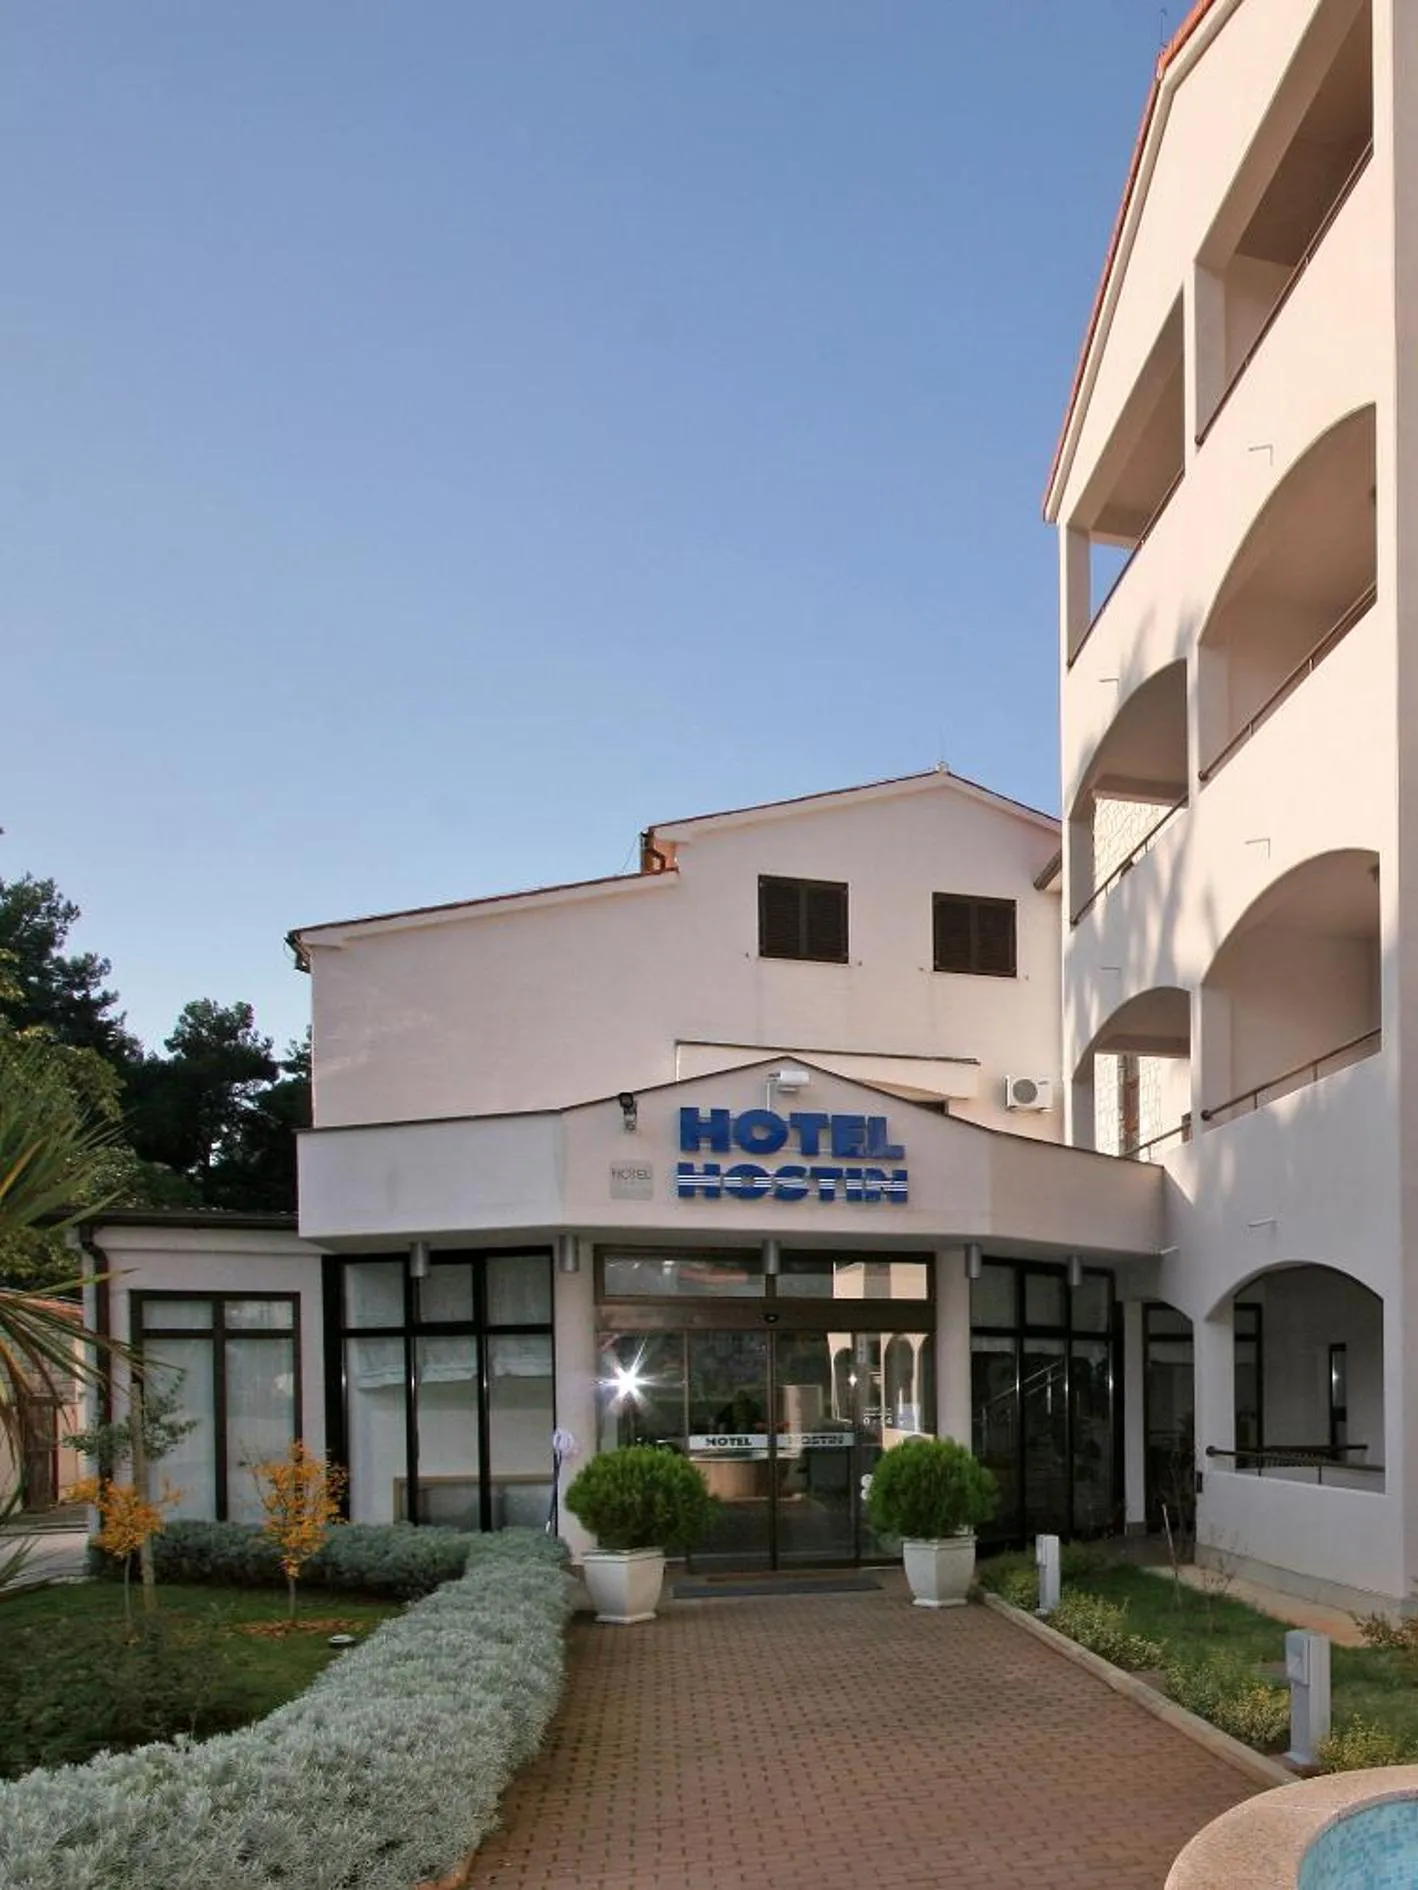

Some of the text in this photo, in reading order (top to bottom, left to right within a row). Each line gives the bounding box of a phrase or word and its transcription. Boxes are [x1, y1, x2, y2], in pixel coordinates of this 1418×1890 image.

[680, 1107, 905, 1160] HOTEL
[611, 1168, 651, 1180] HOTEL
[677, 1162, 908, 1205] HOSTIN
[705, 1437, 752, 1446] HOTEL
